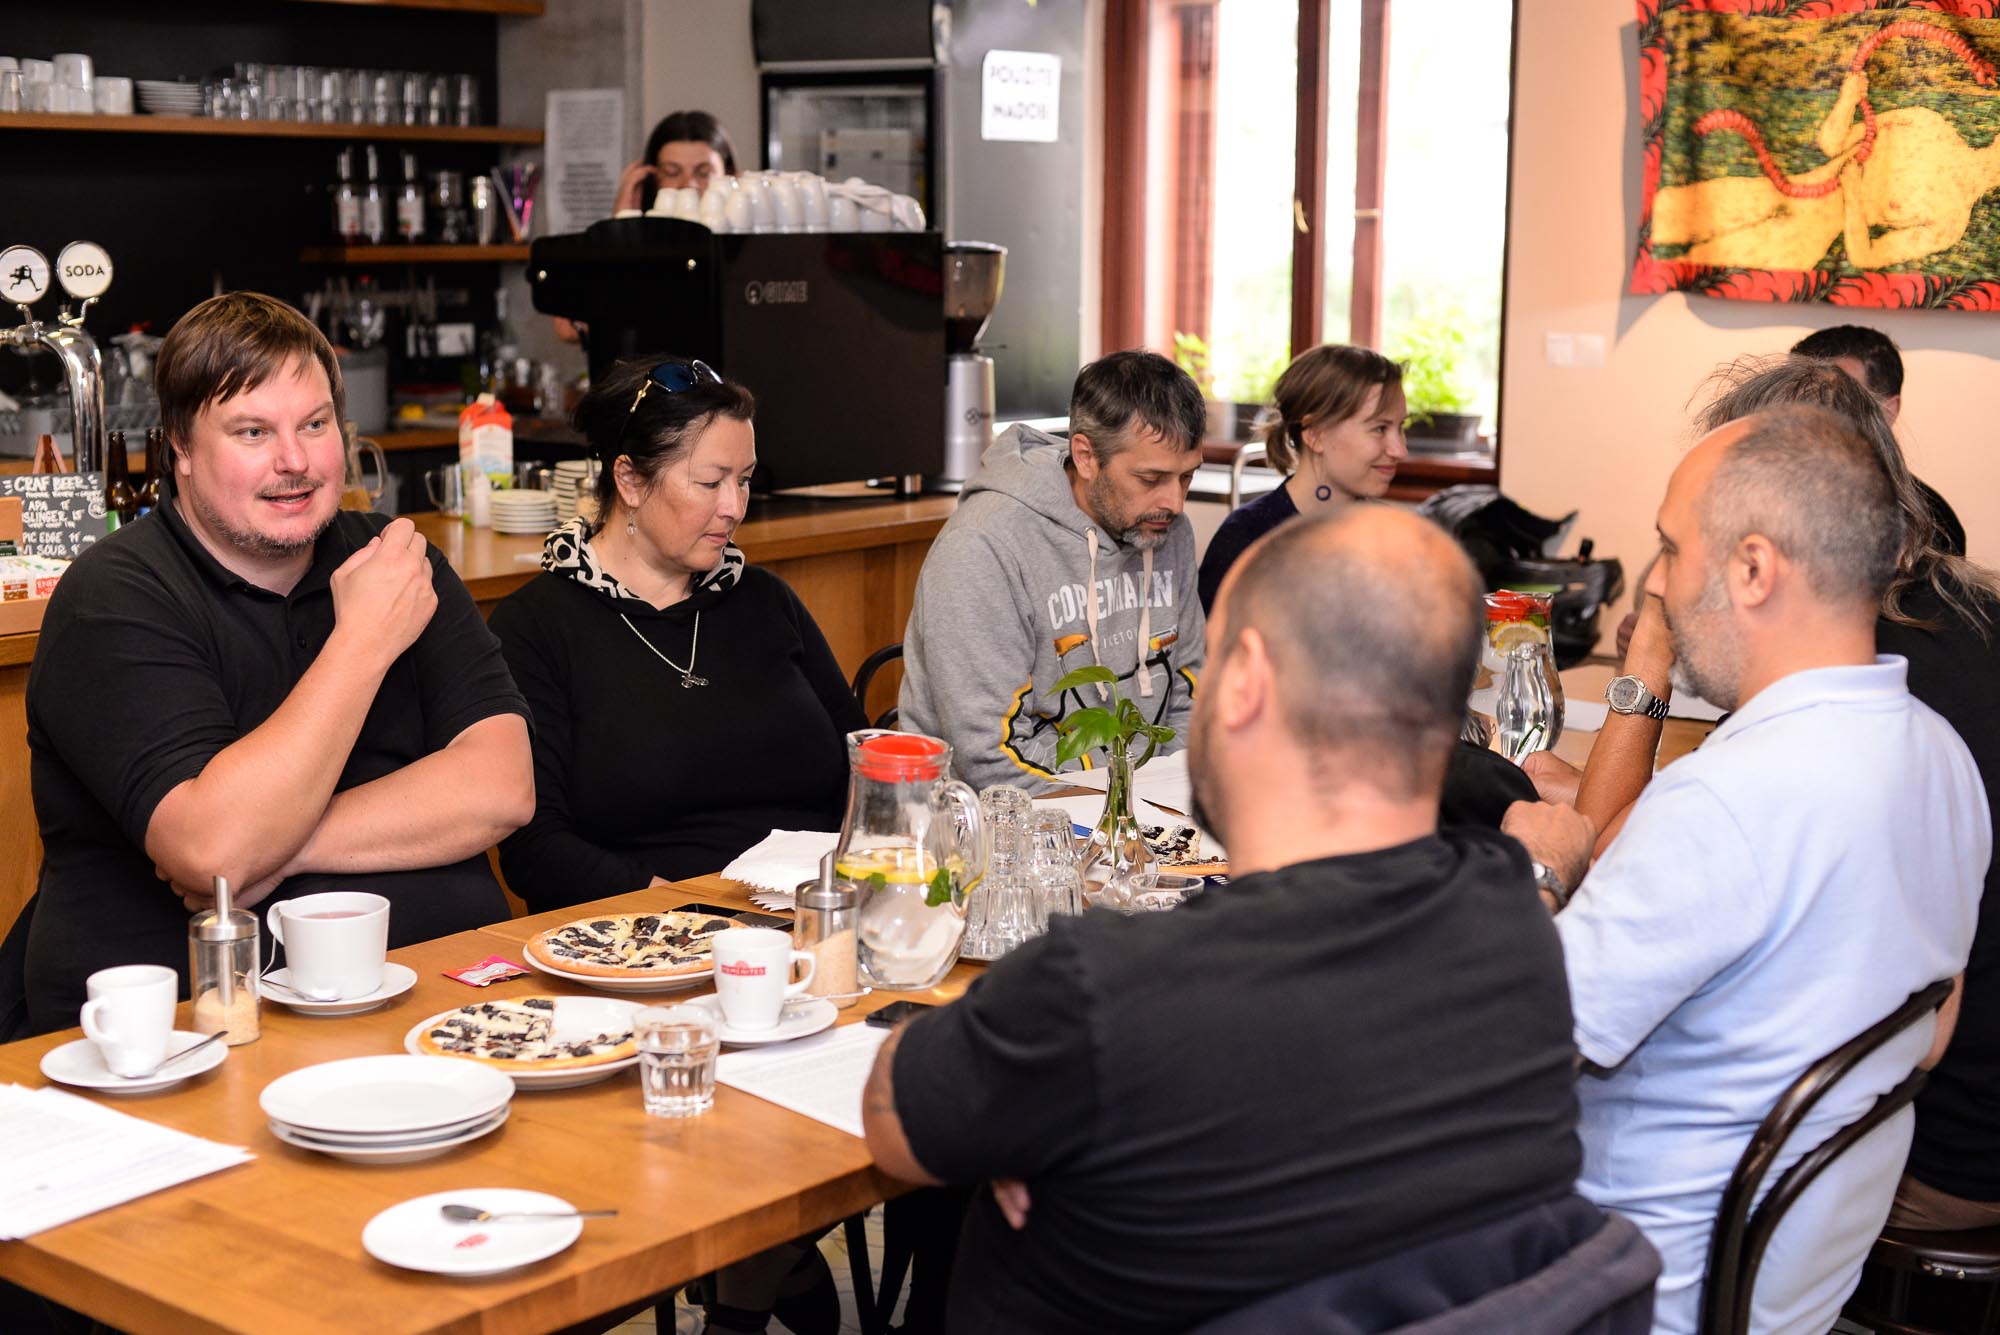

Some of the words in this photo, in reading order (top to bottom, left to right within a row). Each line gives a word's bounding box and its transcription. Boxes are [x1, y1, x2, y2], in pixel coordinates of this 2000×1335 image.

[65, 264, 105, 277] SODA
[53, 476, 88, 490] BEER
[36, 544, 67, 556] SOUR
